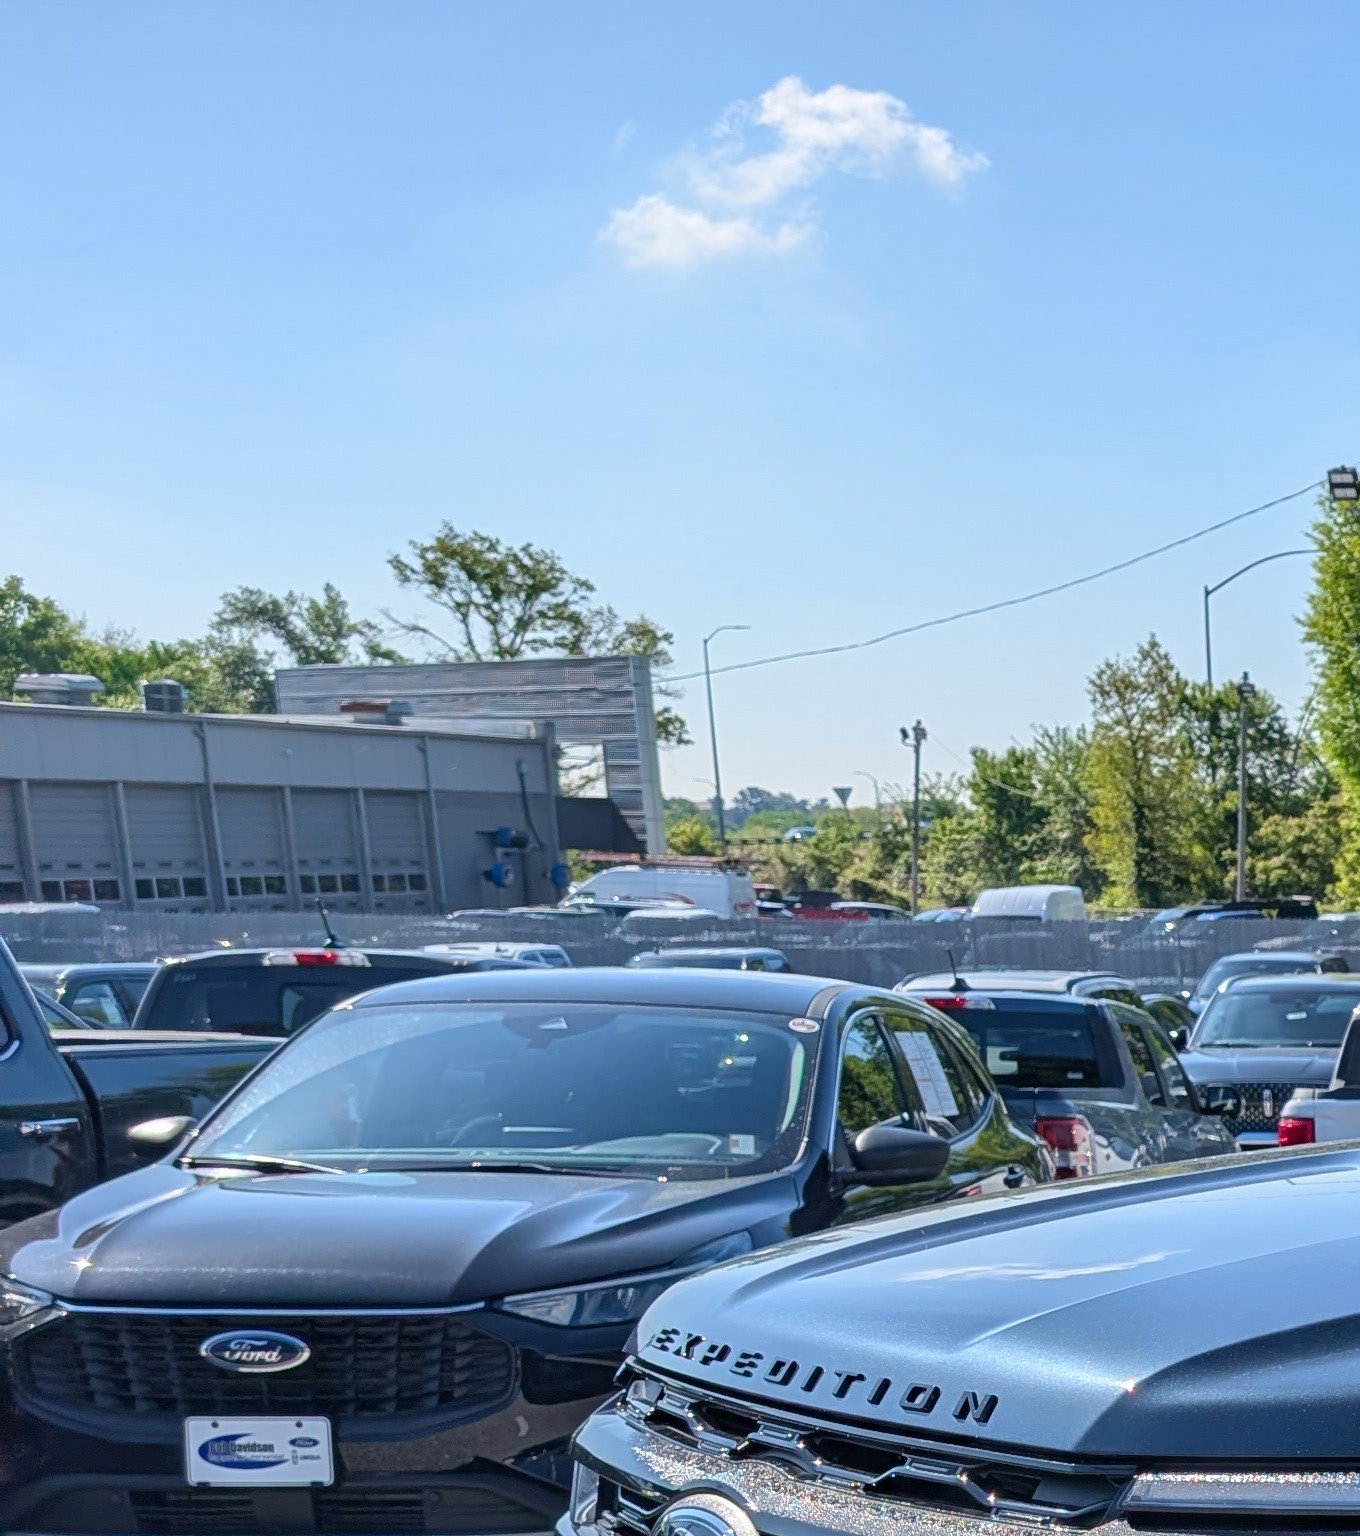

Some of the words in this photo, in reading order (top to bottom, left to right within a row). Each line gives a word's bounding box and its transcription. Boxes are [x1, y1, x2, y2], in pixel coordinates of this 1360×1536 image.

[223, 1338, 282, 1362] Ford
[651, 1327, 999, 1426] EXPEDITION
[230, 1442, 274, 1454] Davidson
